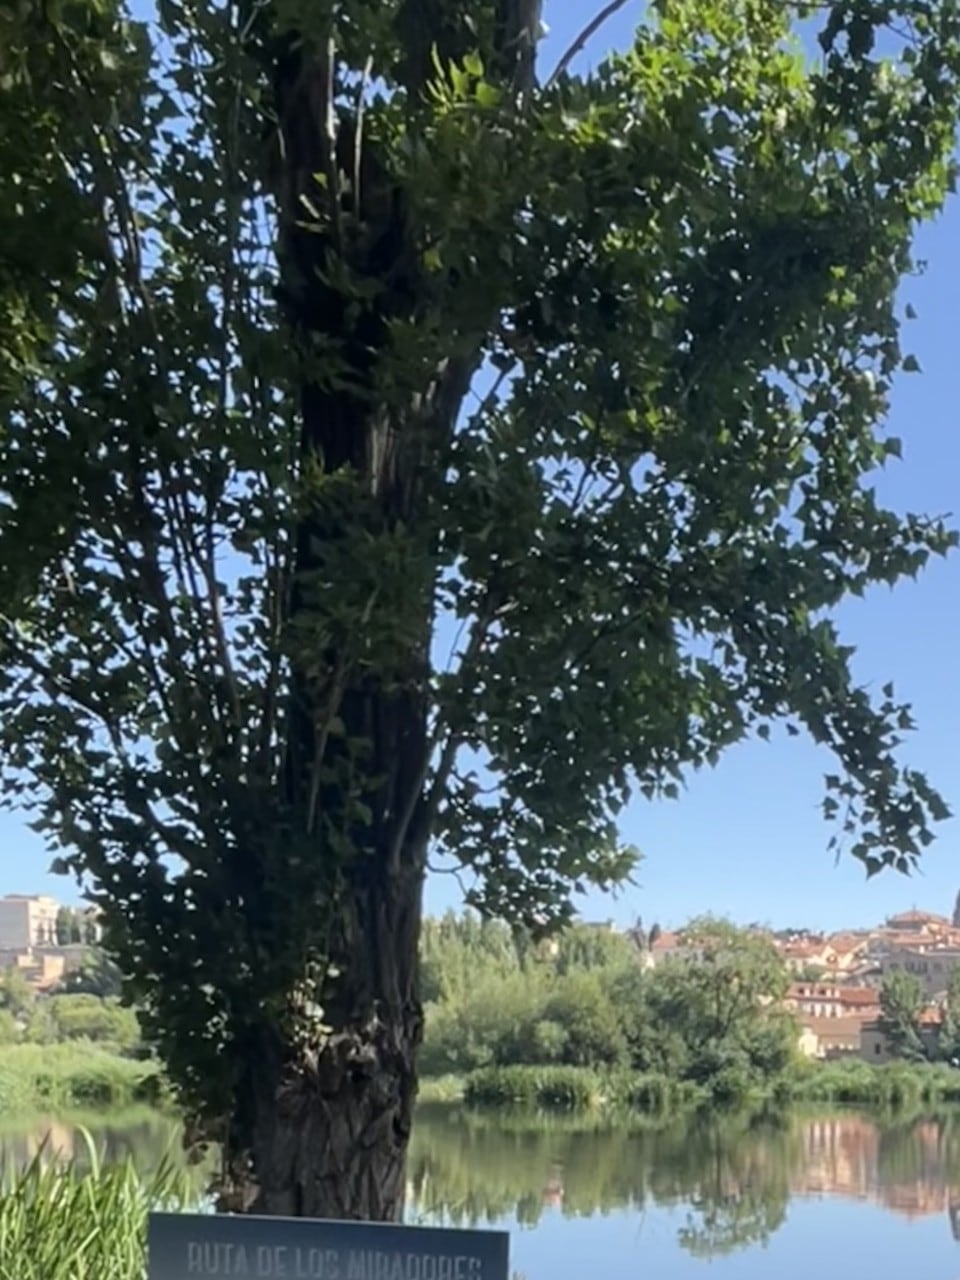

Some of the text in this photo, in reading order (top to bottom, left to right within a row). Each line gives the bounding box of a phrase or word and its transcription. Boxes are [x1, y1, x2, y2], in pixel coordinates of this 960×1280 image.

[187, 1241, 248, 1275] RUTA
[256, 1245, 288, 1278] DE
[294, 1247, 340, 1280] LOS
